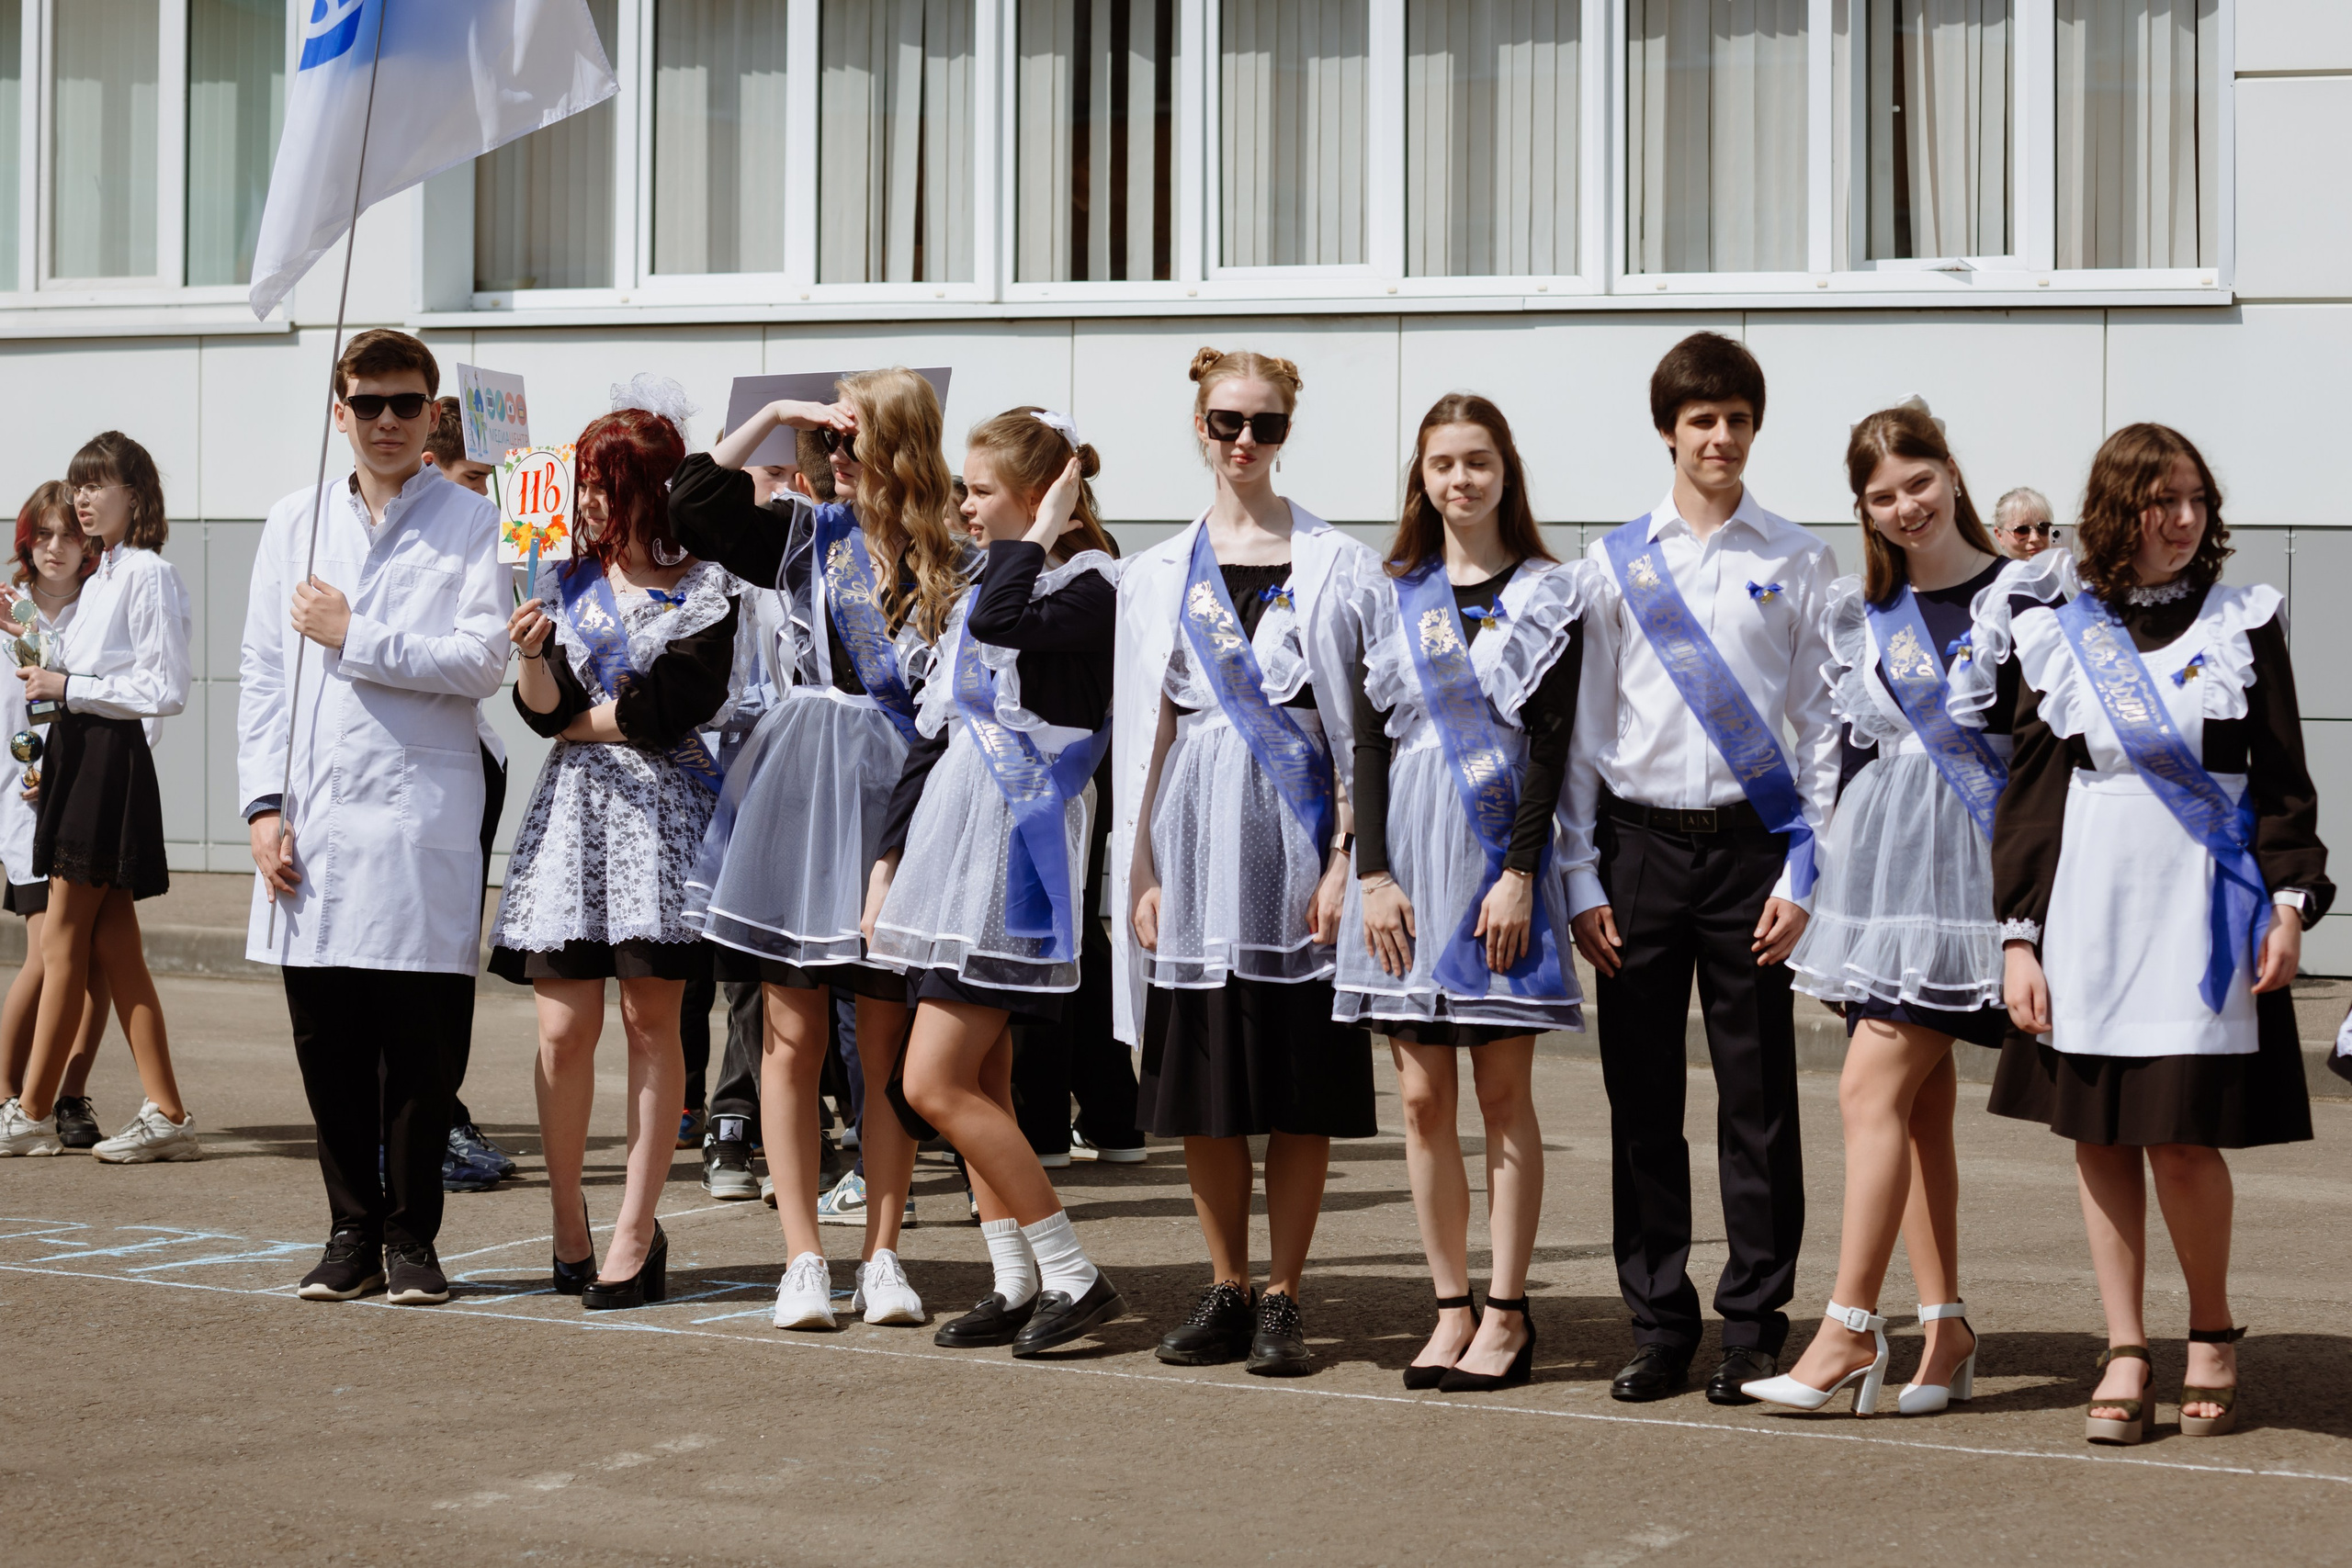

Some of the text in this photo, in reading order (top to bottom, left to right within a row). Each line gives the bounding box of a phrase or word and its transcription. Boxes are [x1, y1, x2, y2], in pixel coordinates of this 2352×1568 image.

[490, 428, 527, 447] МЕДИАЦЕНТР
[1201, 622, 1301, 756] Выпускник
[1430, 648, 1505, 798] Выпускник
[1644, 596, 1781, 781] Выпускник 2024
[993, 754, 1054, 803] 2024
[2168, 782, 2235, 835] 2024
